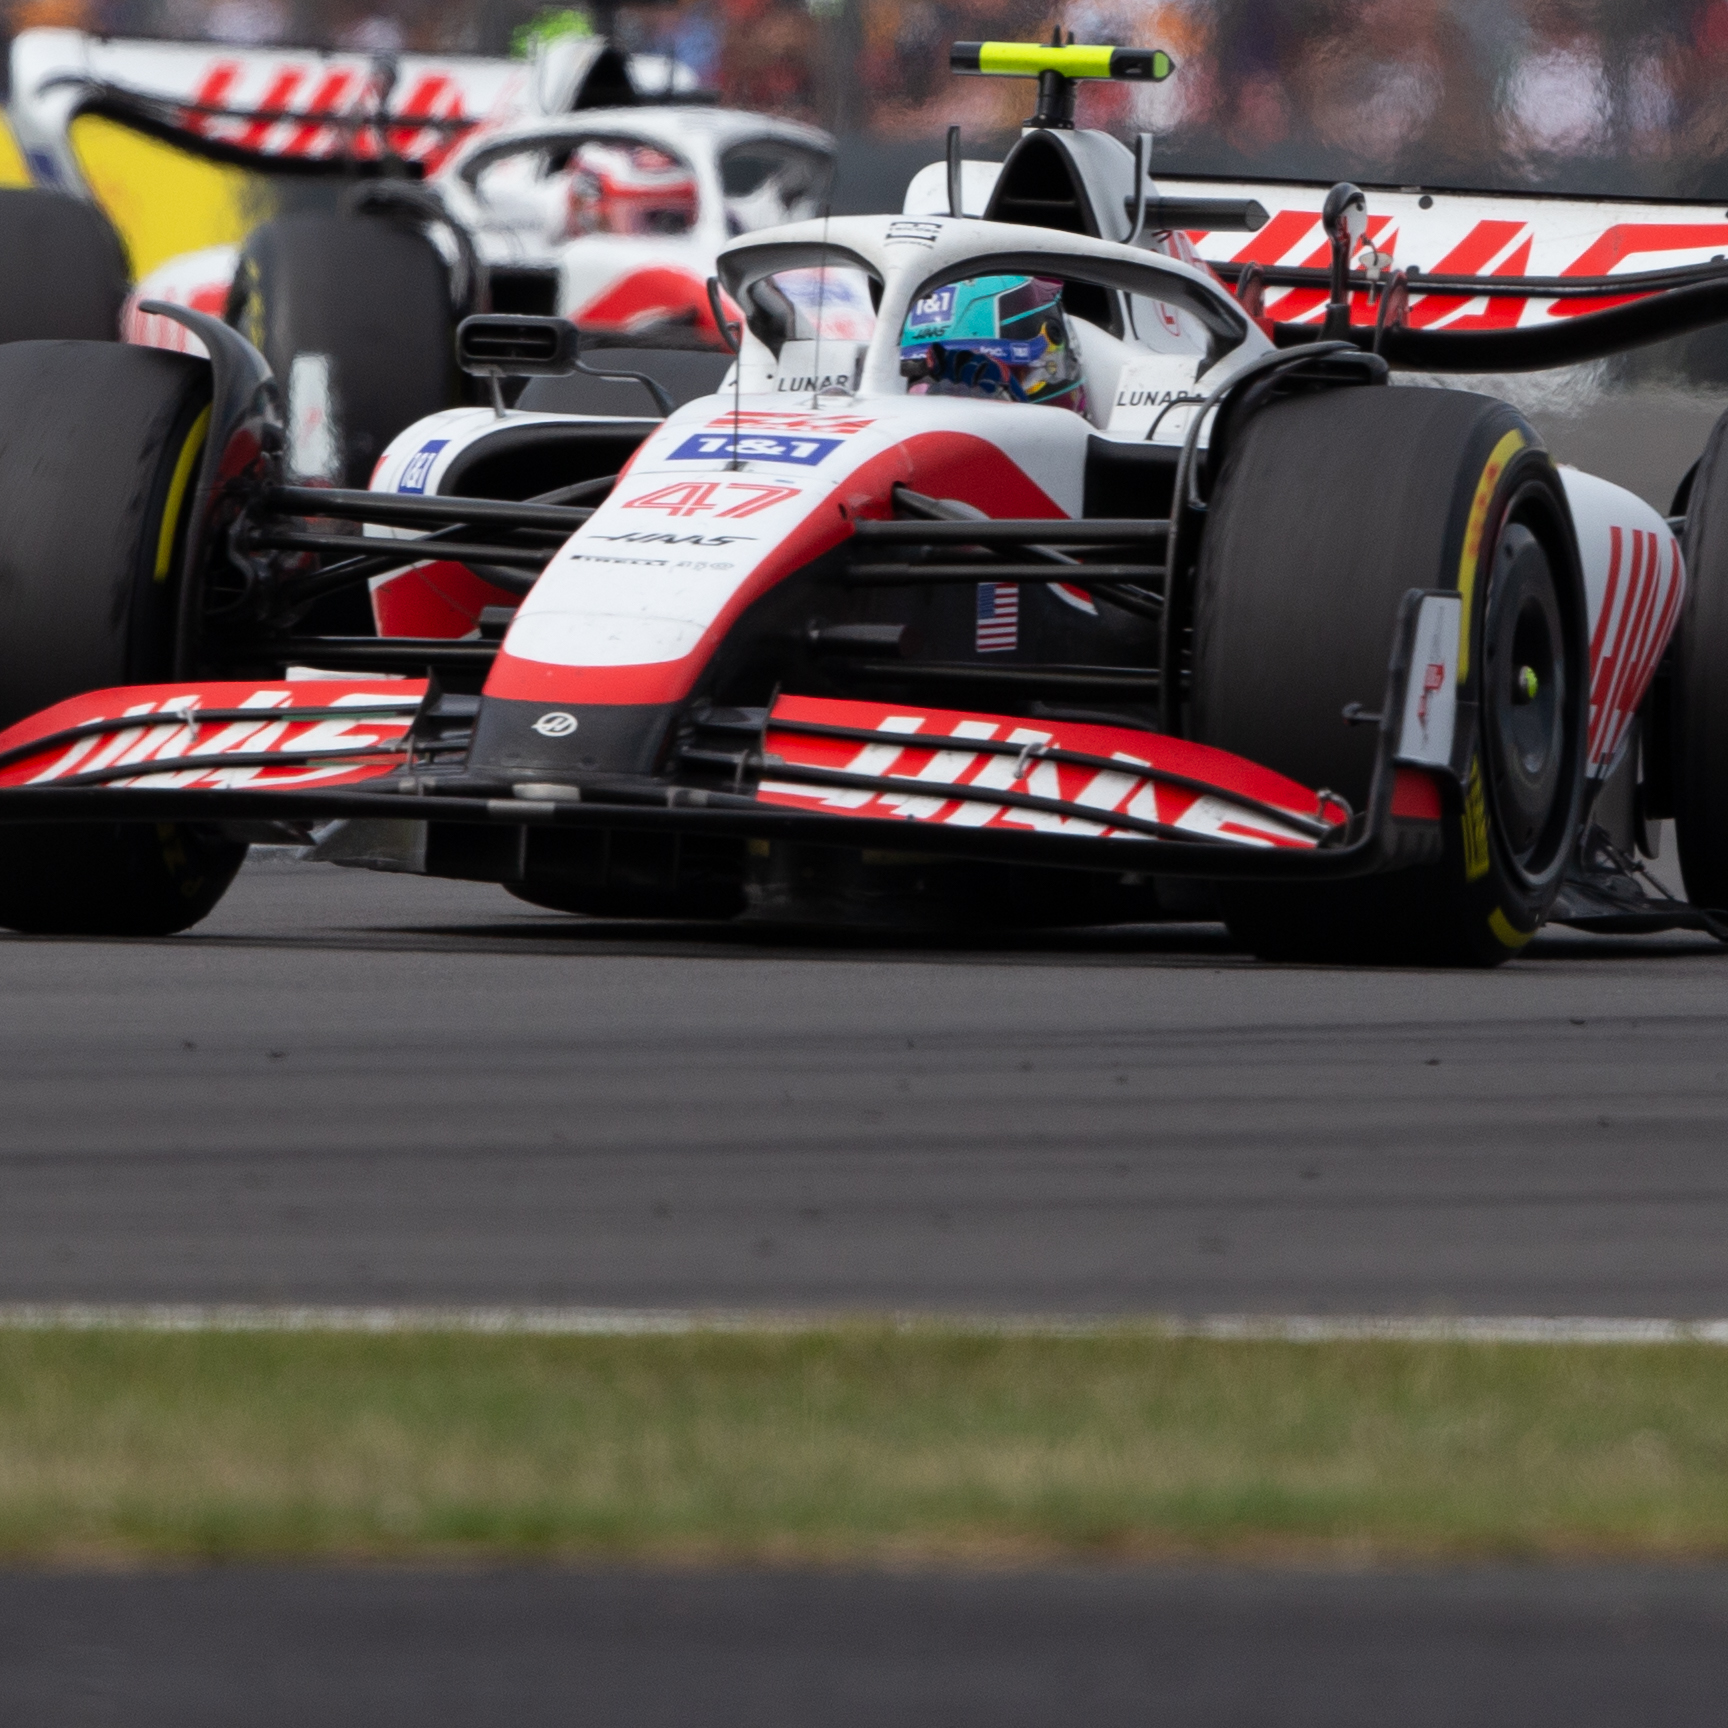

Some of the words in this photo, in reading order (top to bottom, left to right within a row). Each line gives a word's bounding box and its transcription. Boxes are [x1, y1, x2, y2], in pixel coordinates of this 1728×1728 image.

[693, 436, 821, 459] 1&1
[620, 481, 803, 519] 47
[587, 532, 760, 547] HAAS
